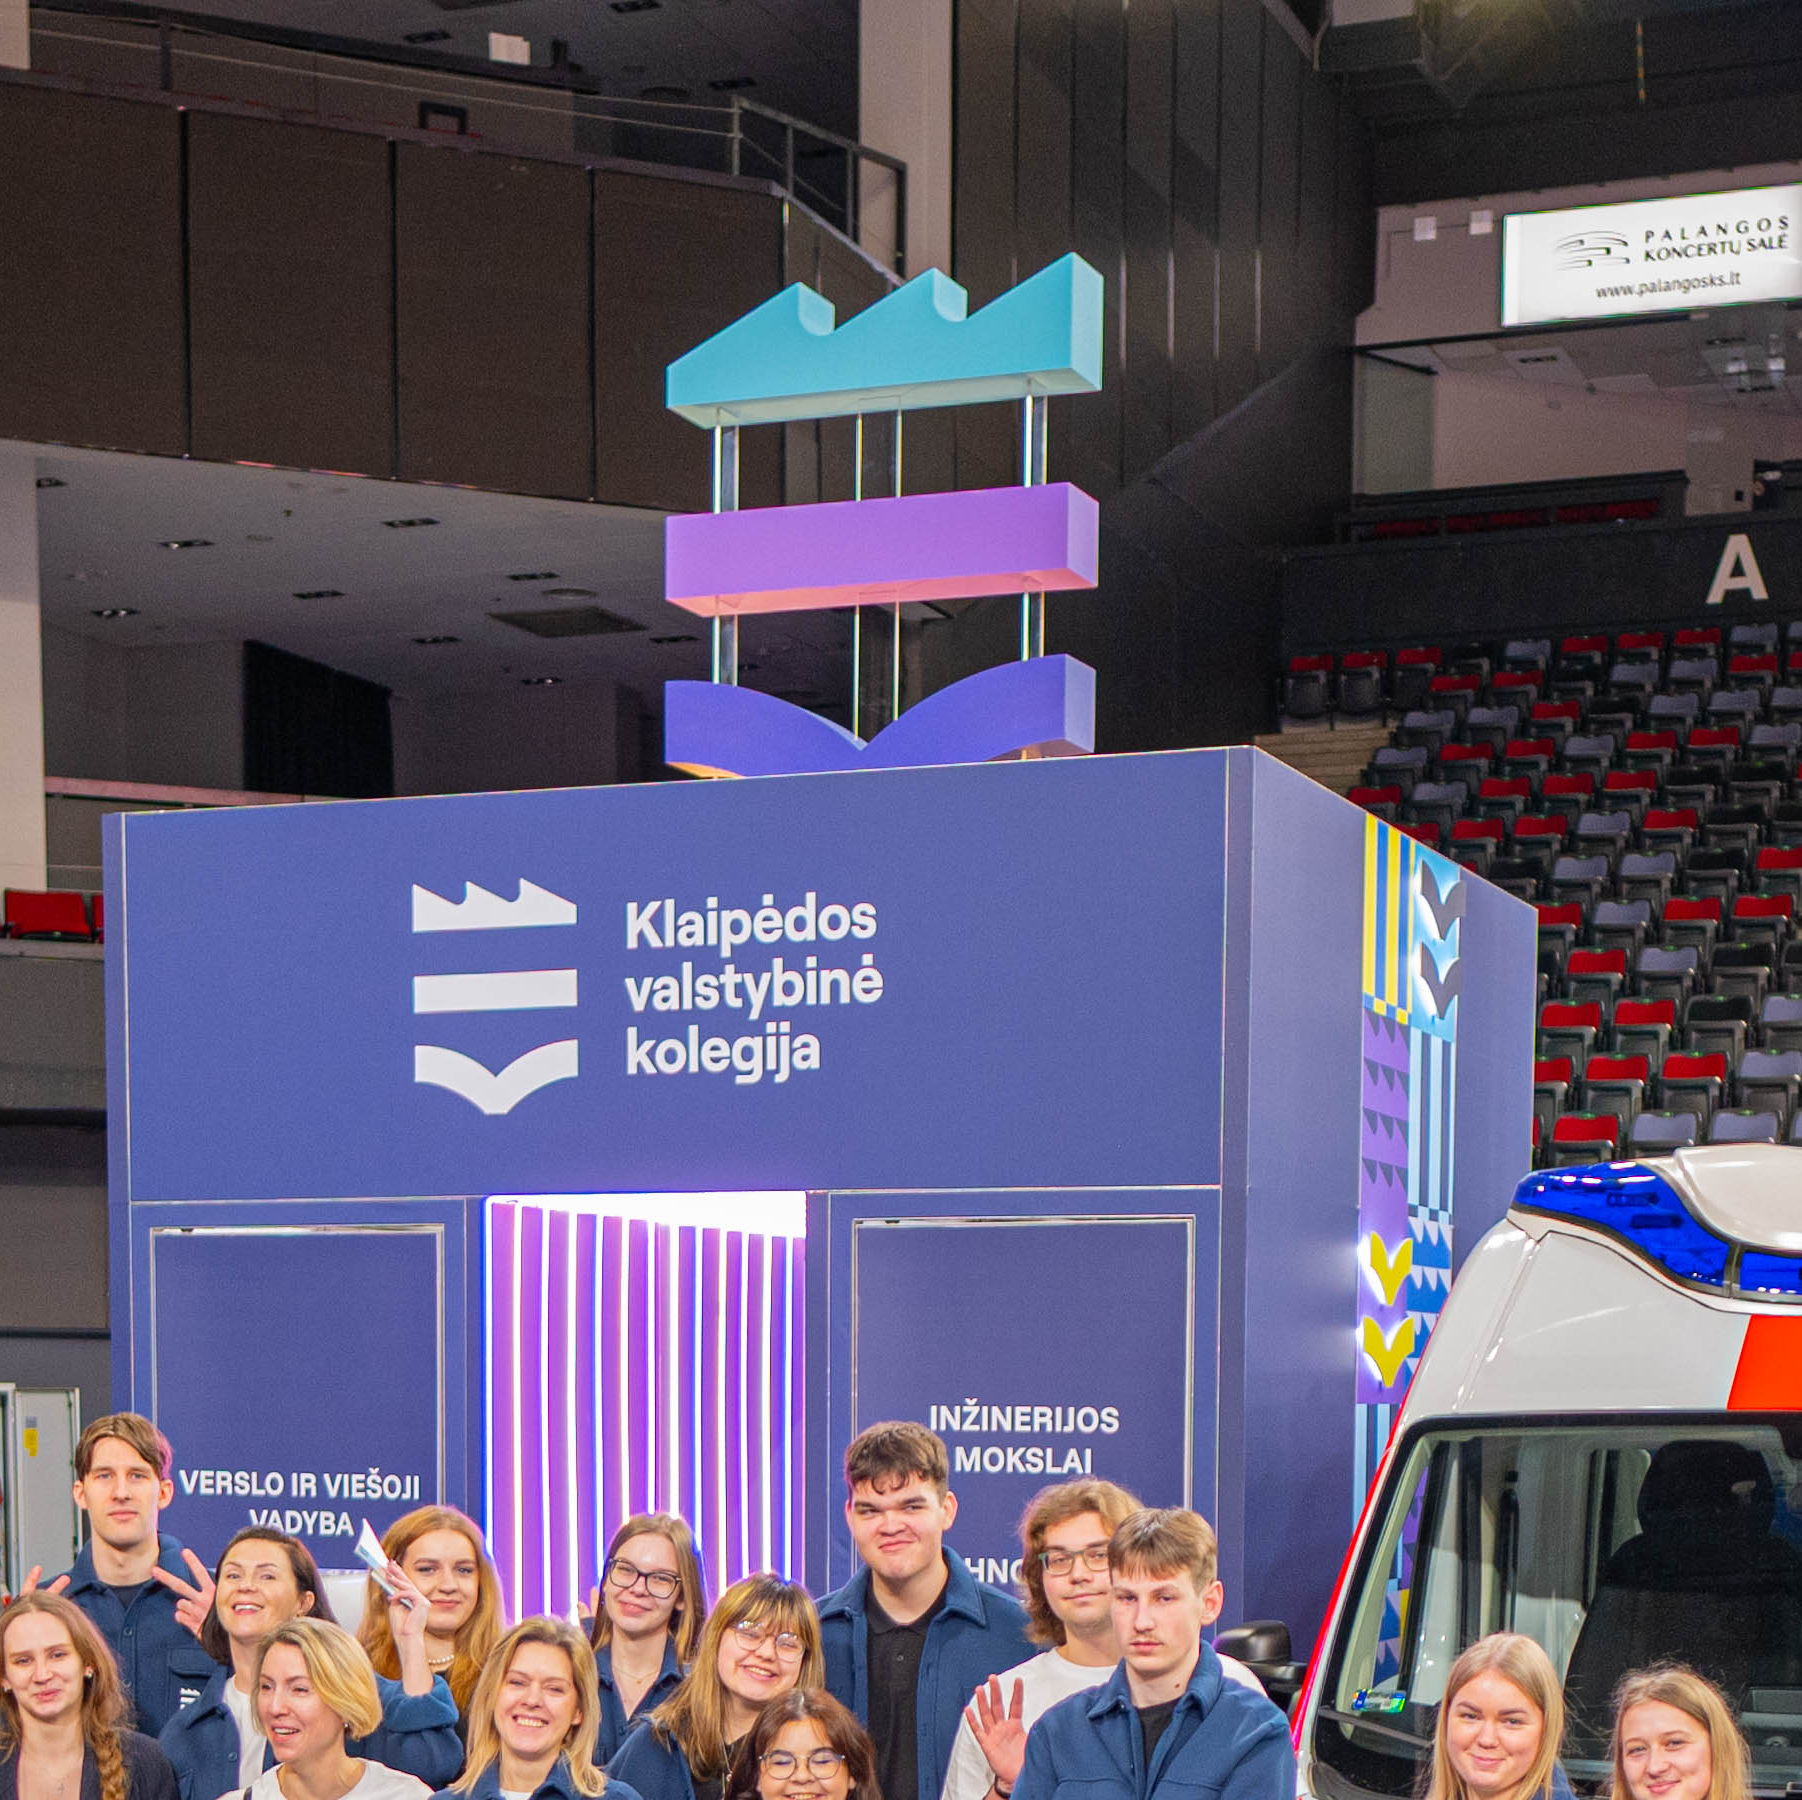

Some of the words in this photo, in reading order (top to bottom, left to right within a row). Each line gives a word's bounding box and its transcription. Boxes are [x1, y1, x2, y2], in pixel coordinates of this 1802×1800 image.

[1644, 214, 1790, 244] PALANGOS
[1643, 240, 1742, 263] KONCERTŲ
[1746, 231, 1790, 252] SALĖ
[1595, 269, 1742, 299] www.palangosks.lt
[1705, 533, 1769, 604] A
[625, 890, 878, 958] Klaipėdos
[623, 952, 885, 1021] valstybinė
[625, 1019, 821, 1086] kolegija
[929, 1397, 1121, 1435] INŽINERIJOS
[954, 1446, 1093, 1475] MOKSLAI
[178, 1469, 285, 1497] VERSLO
[291, 1472, 318, 1498] IR
[323, 1467, 421, 1500] VIEŠOJI
[248, 1508, 355, 1537] VADYBA
